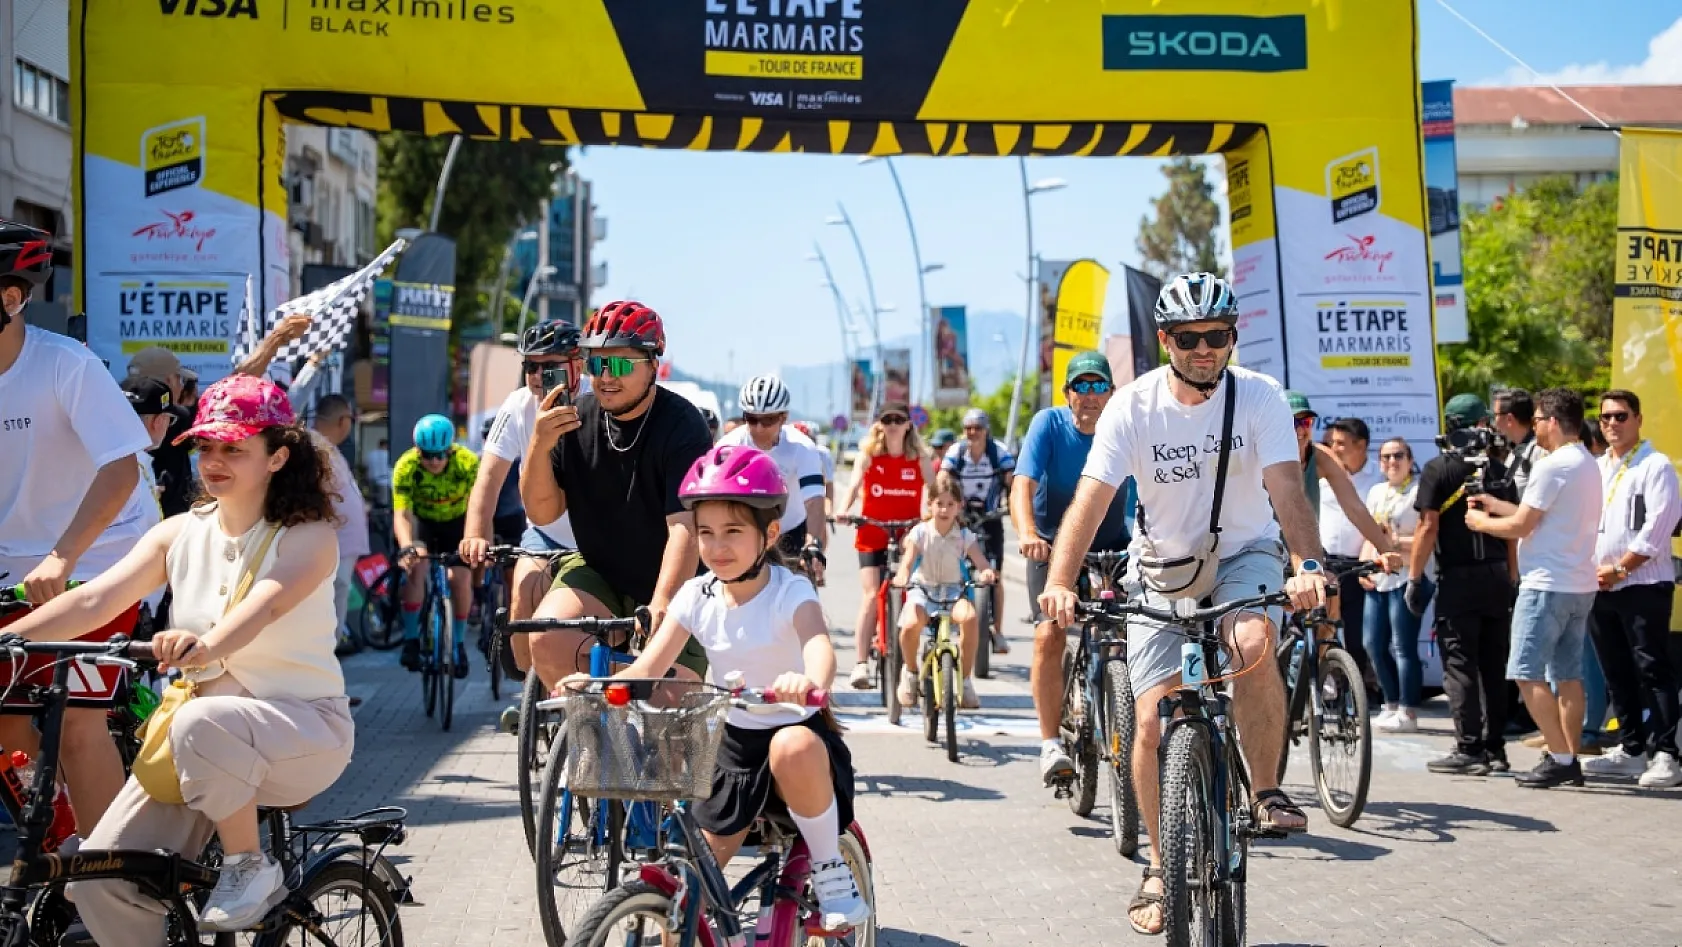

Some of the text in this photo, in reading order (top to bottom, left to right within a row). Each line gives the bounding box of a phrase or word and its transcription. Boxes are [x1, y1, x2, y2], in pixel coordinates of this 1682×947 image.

[310, 16, 389, 37] BLACK
[705, 20, 864, 51] MARMARİS
[759, 59, 790, 73] TOUR
[793, 61, 808, 74] DE
[810, 61, 856, 75] FRANCE
[750, 91, 783, 106] VISA
[119, 282, 229, 316] L'ÉTAPE
[1317, 301, 1408, 333] L'ÉTAPE
[120, 318, 229, 338] MARMARİS
[1318, 334, 1411, 353] MARMARİS
[3, 417, 31, 431] STOP
[1150, 434, 1245, 462] Keep Cam
[1154, 468, 1170, 483] &
[68, 852, 124, 875] Cunda
